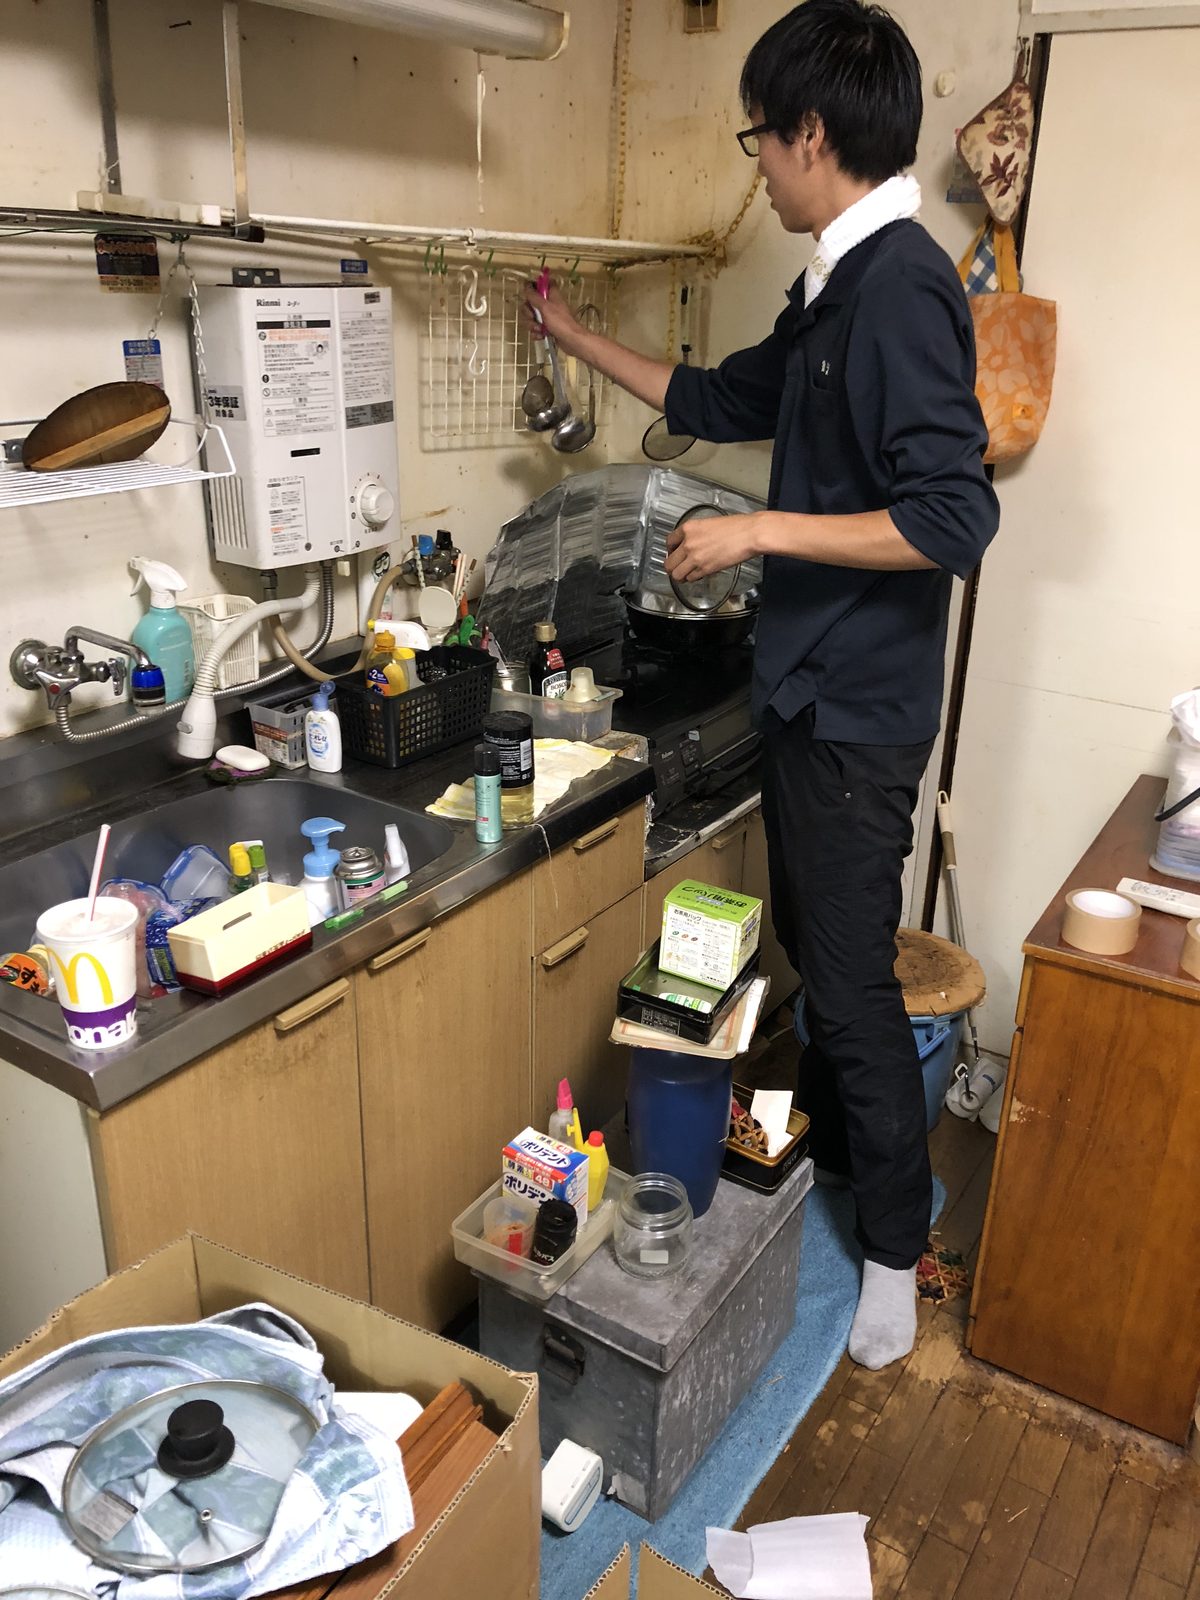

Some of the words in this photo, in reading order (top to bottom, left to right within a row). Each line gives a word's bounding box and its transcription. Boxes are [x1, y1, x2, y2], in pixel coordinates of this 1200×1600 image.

[256, 299, 281, 307] Rinnai
[207, 396, 239, 408] 3年保証
[521, 1141, 567, 1165] ポリデント
